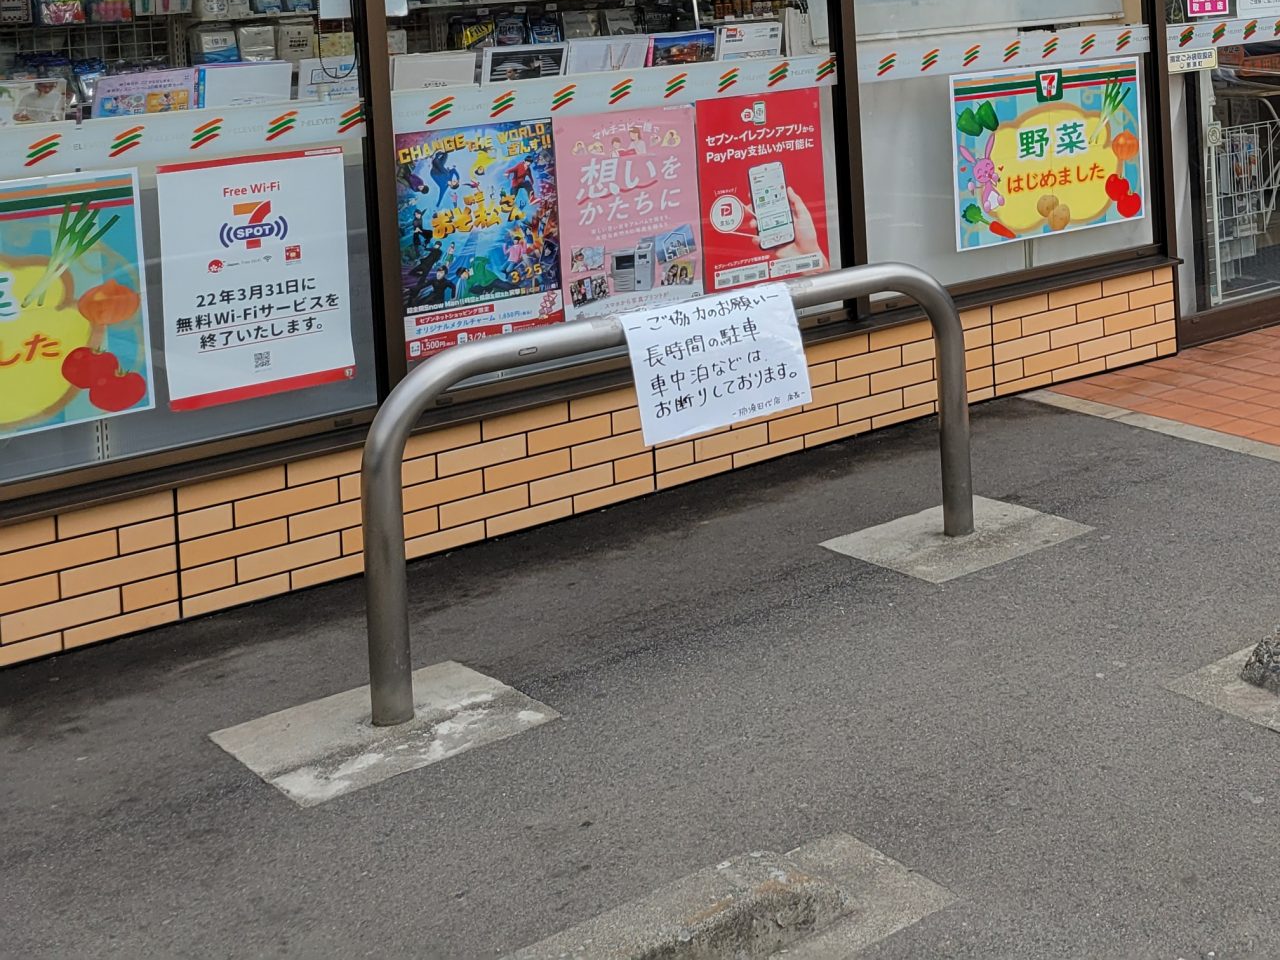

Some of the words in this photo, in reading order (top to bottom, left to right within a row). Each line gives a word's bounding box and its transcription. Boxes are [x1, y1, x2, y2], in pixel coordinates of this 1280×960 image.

[398, 134, 465, 164] CHANGE
[497, 123, 545, 145] WORLD
[705, 123, 815, 147] セブン-イレブンアプリから
[706, 137, 815, 163] PayPay支払いが可能に
[1018, 121, 1087, 159] 野菜
[223, 187, 247, 198] Free
[250, 181, 281, 194] Wi-Fi
[575, 155, 681, 200] 想いを
[1007, 163, 1105, 194] はじめました
[578, 188, 681, 226] かたちに
[236, 225, 272, 239] SPOT
[195, 277, 316, 309] 22年3月31日に
[175, 294, 340, 334] 無料Wi-Fiサービスを
[199, 316, 324, 350] 終了いたします。
[643, 317, 761, 368] 長時間の駐車
[654, 362, 798, 419] お断りしております。
